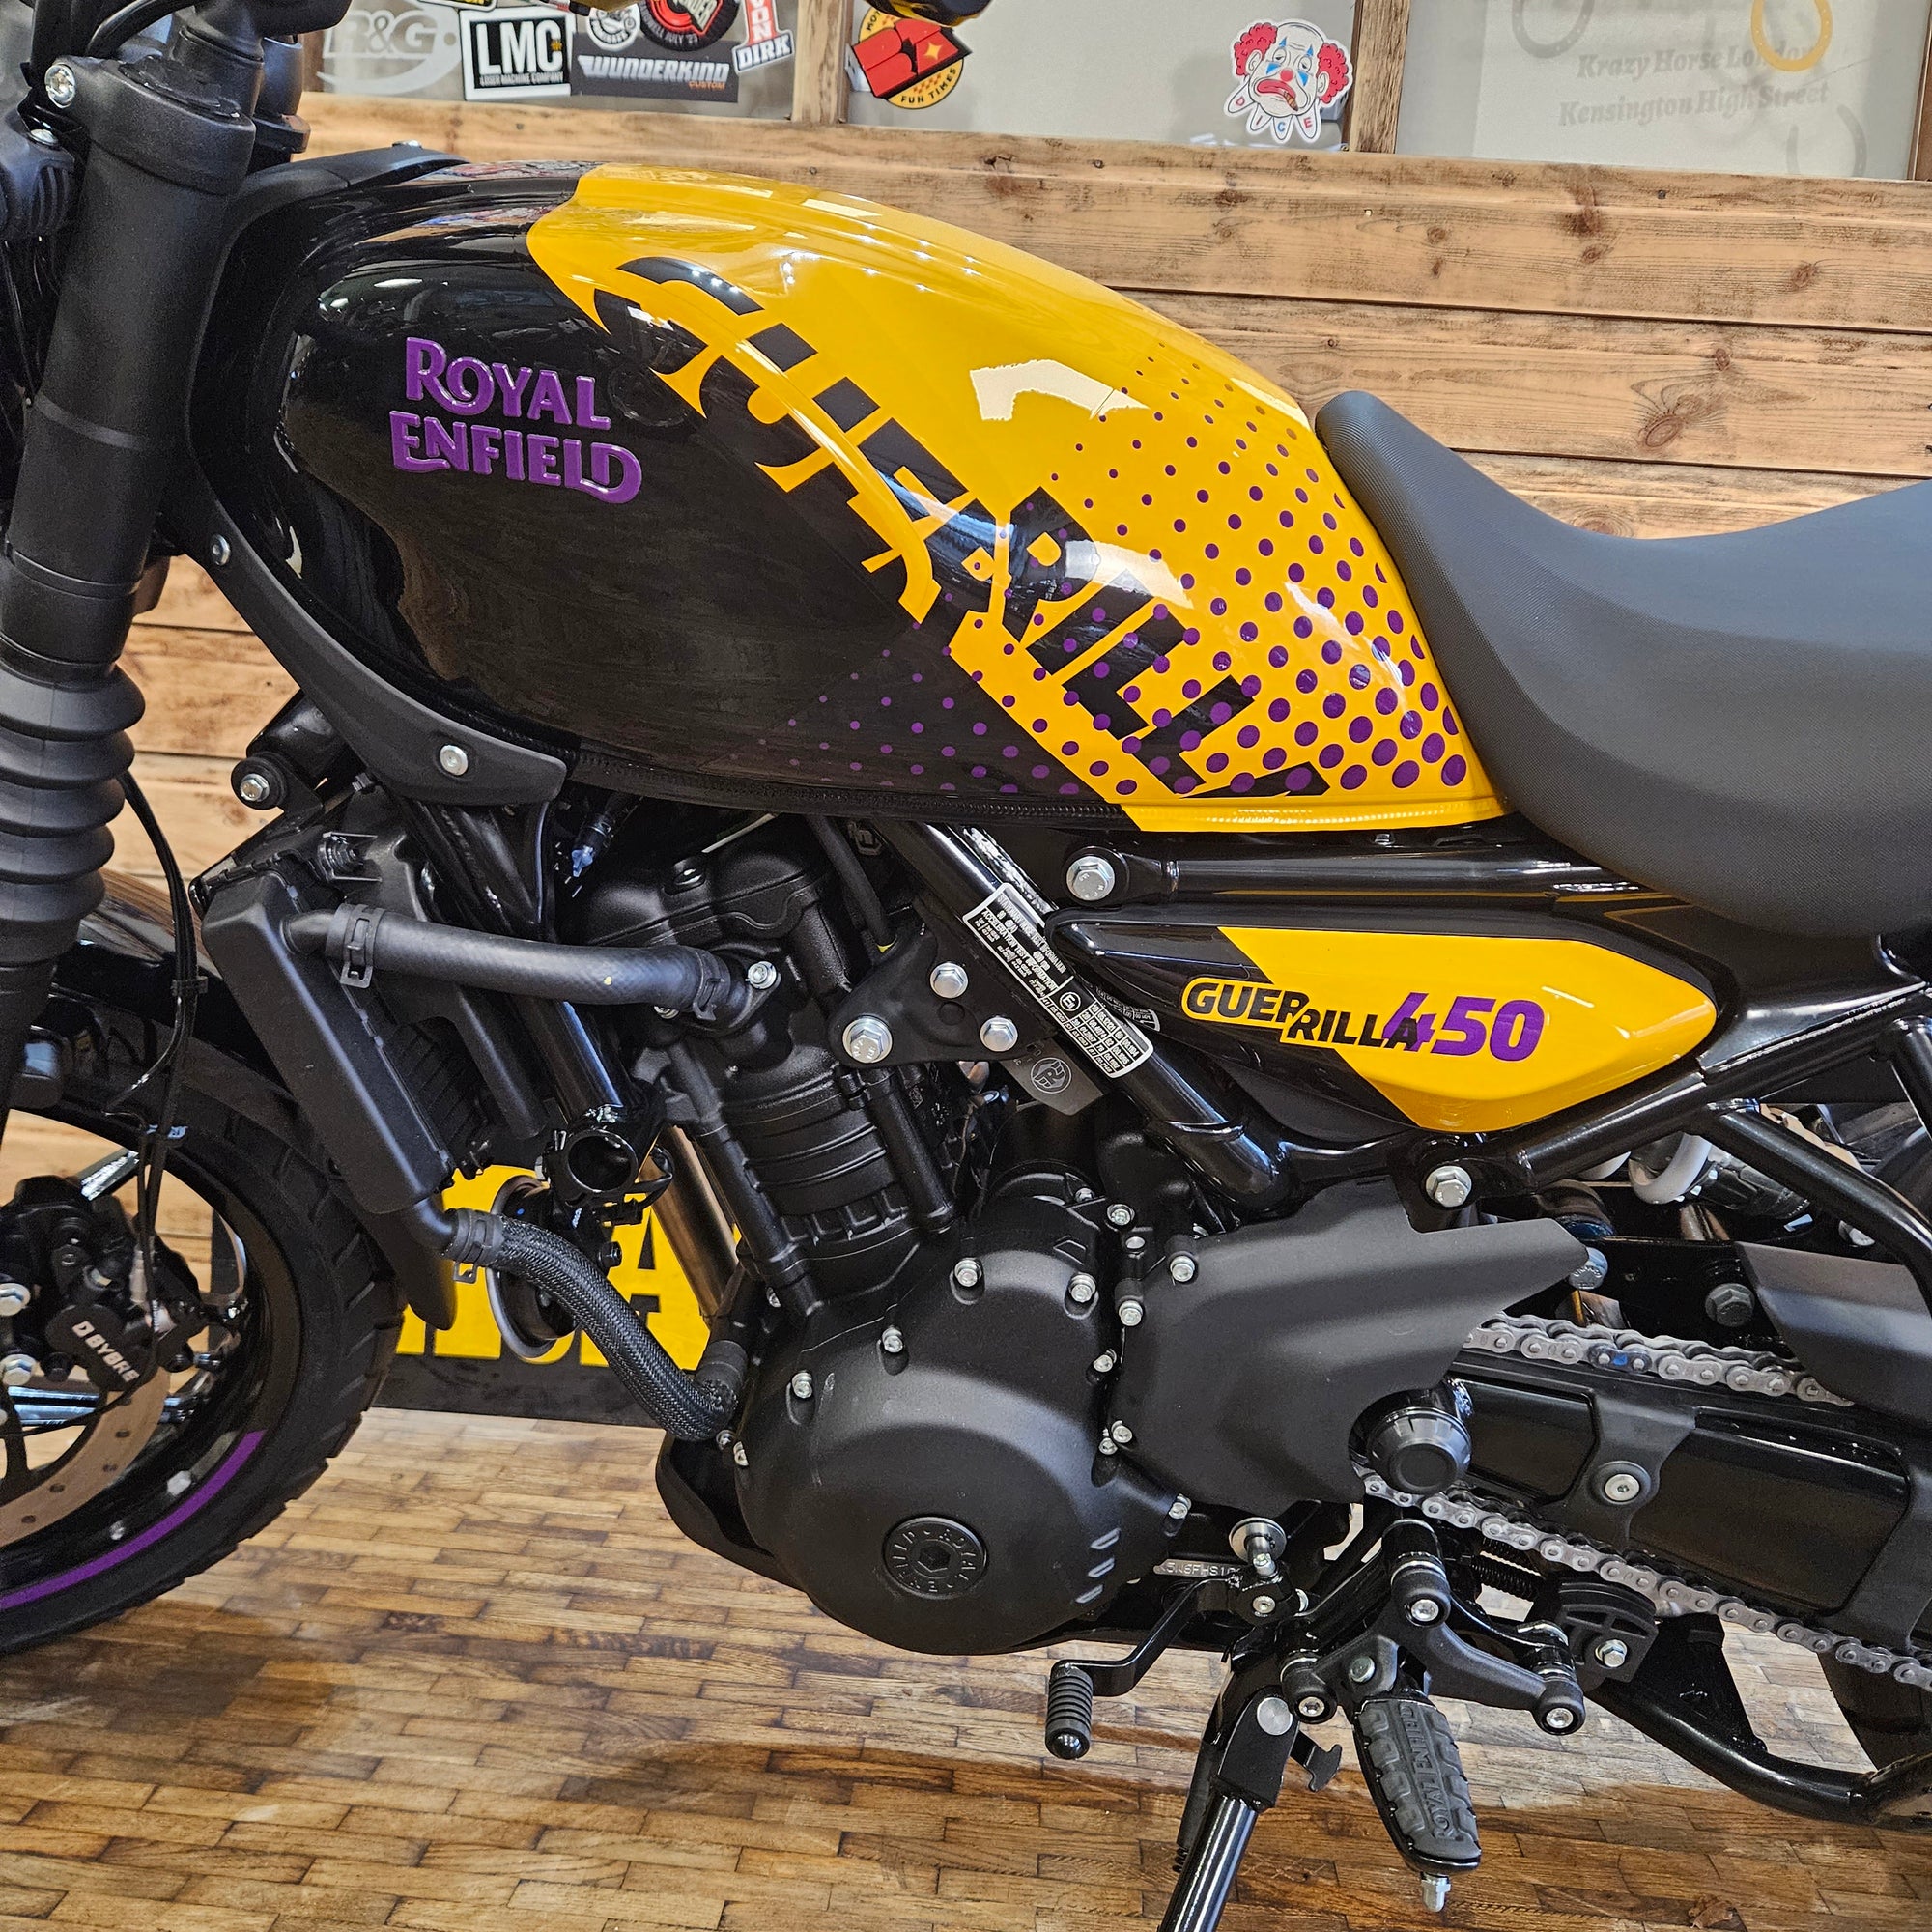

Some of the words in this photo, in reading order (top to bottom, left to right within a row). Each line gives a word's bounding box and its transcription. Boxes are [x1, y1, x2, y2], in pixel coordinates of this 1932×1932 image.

[476, 19, 563, 75] LMC
[578, 55, 730, 83] WUNDERKIND
[736, 34, 792, 70] DIRK
[1577, 53, 1648, 83] Krazy
[1653, 49, 1724, 73] Horse
[689, 81, 725, 91] CUSTOM
[901, 95, 924, 104] FUN
[928, 67, 956, 99] TIMES
[1558, 96, 1693, 126] Kensington
[1694, 87, 1753, 119] High
[1756, 82, 1829, 109] Street
[406, 337, 611, 430] ROYAL
[389, 411, 642, 504] ENFIELD
[980, 909, 1017, 947] ACCELERATION
[1013, 945, 1029, 960] TEST
[1024, 956, 1056, 991] INFORMATION
[1029, 932, 1044, 948] TEST
[1186, 981, 1419, 1050] GUERRILLA
[1382, 992, 1546, 1062] 450
[84, 1333, 140, 1383] BYBRE
[1397, 1698, 1437, 1779] ENFIELD
[1419, 1776, 1457, 1844] ROYAL
